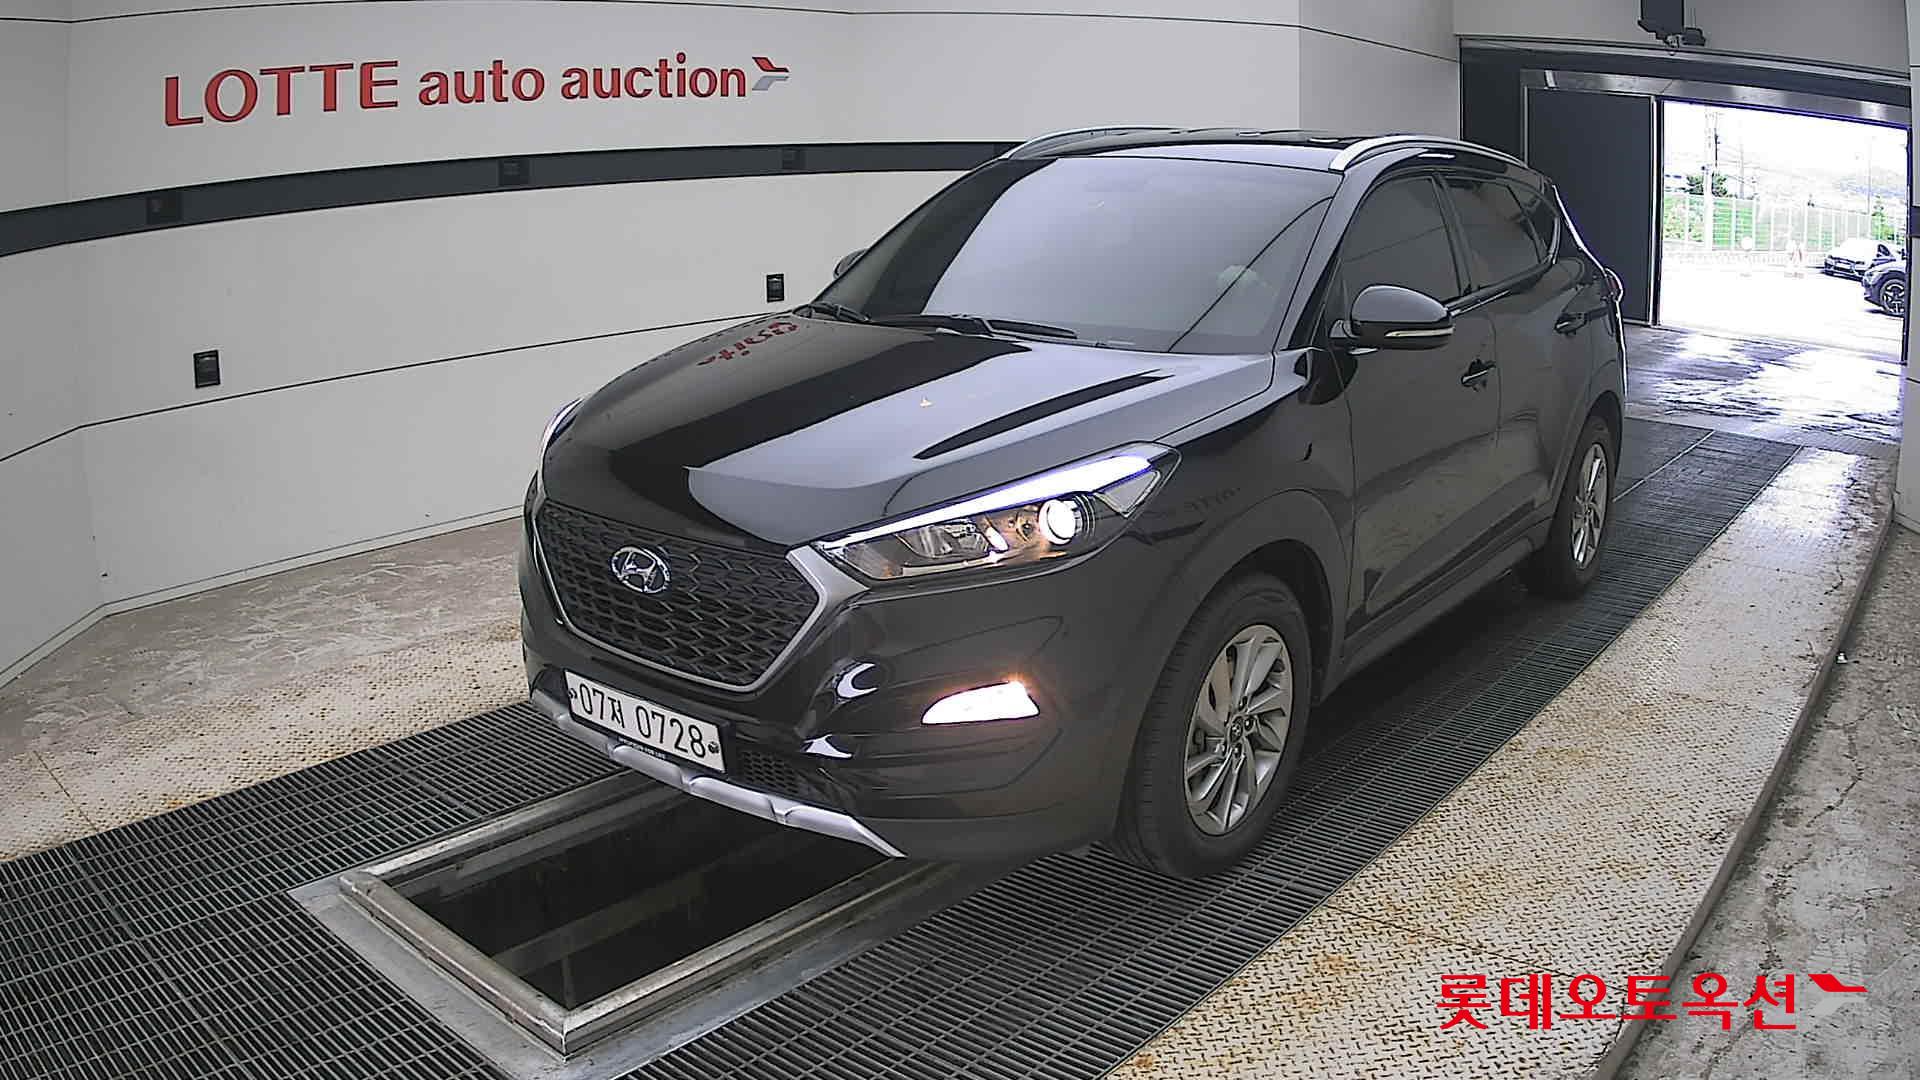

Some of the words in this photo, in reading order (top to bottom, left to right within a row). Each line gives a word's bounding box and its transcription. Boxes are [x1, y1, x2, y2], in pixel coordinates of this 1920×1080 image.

[164, 60, 398, 126] LOTTE
[418, 60, 545, 105] auto
[560, 52, 747, 98] auction
[579, 683, 625, 728] 07저
[635, 705, 706, 758] 0728
